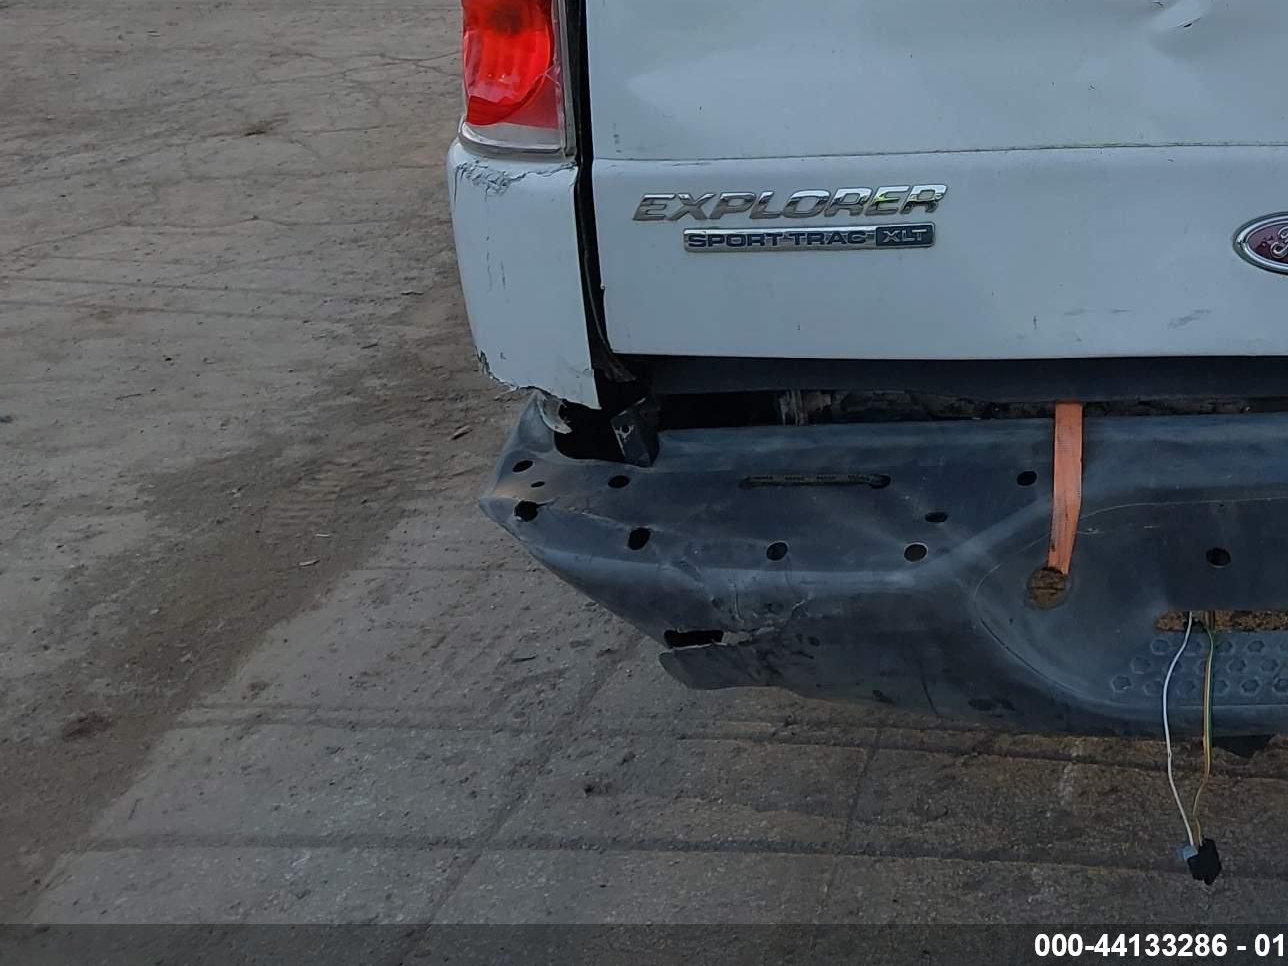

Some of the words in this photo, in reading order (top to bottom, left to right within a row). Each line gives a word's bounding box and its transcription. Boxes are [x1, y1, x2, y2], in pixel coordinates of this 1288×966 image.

[632, 183, 948, 222] EXPLORER
[687, 232, 784, 249] SPORT
[789, 230, 867, 247] TRAC
[881, 227, 928, 243] XLT
